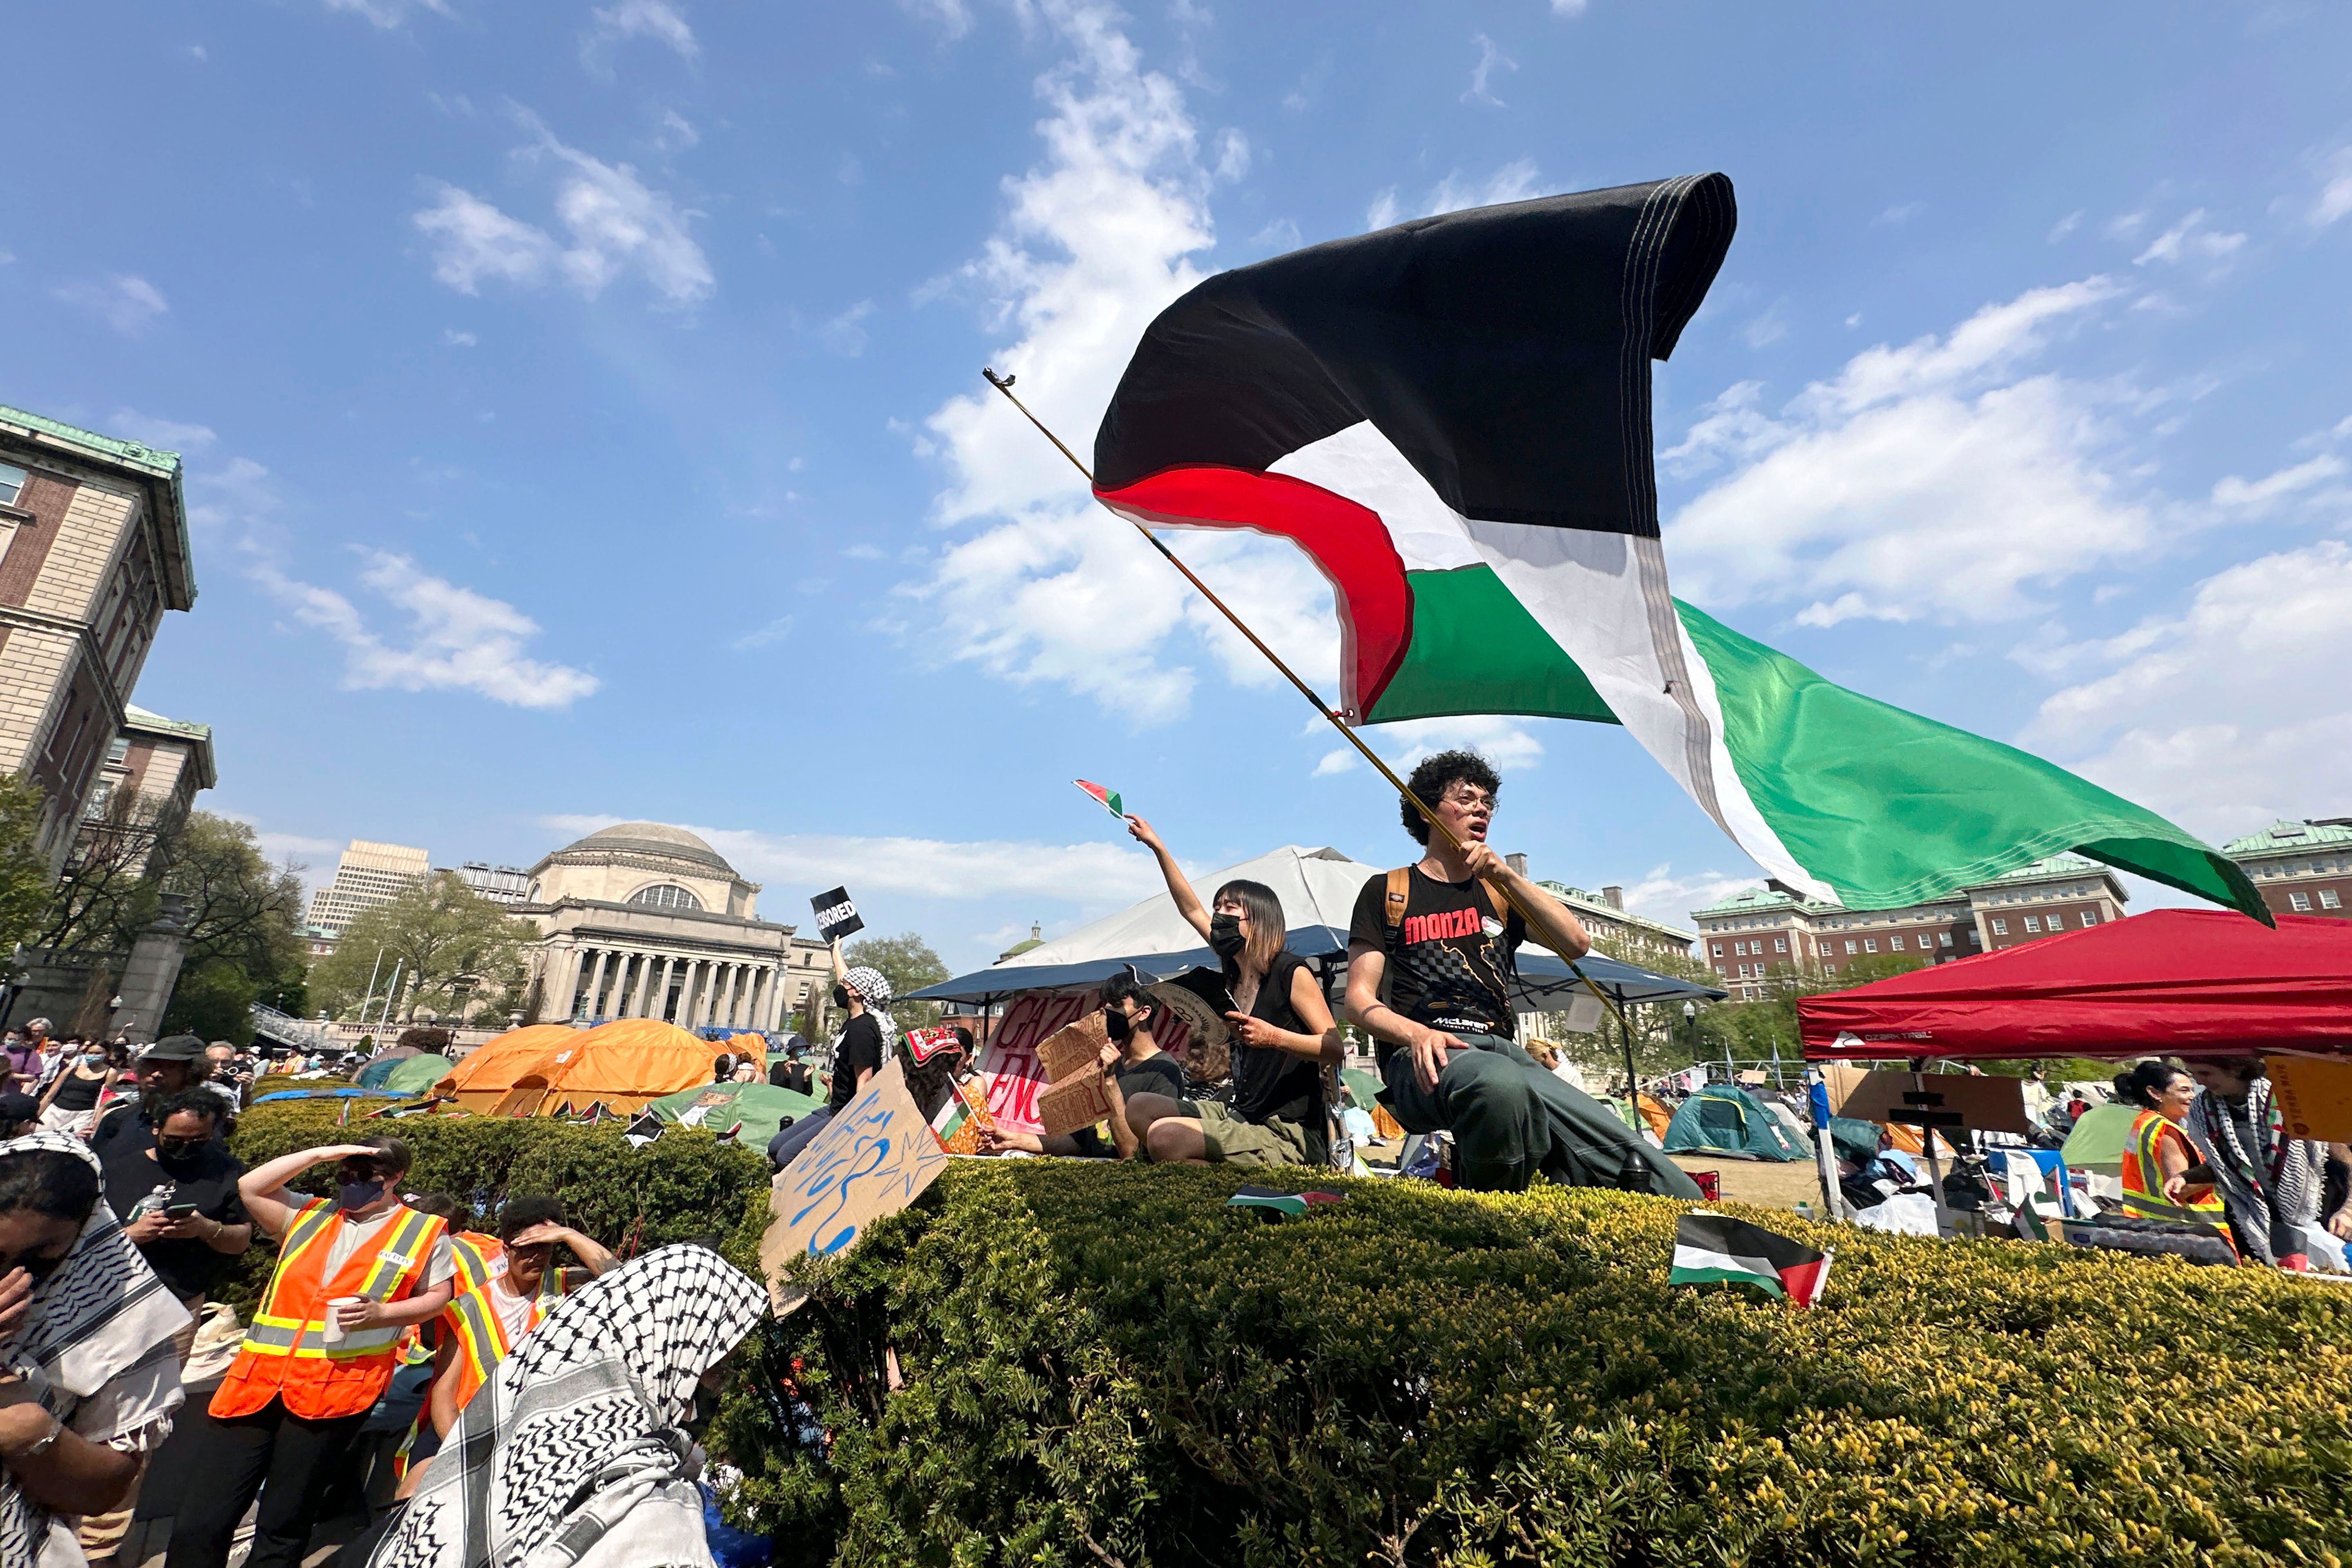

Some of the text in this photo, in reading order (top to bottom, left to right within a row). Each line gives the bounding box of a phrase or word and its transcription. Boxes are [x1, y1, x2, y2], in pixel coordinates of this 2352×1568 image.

[815, 900, 856, 931] CENSORED
[996, 995, 1086, 1049] GAZA
[379, 1251, 409, 1264] FACULTY
